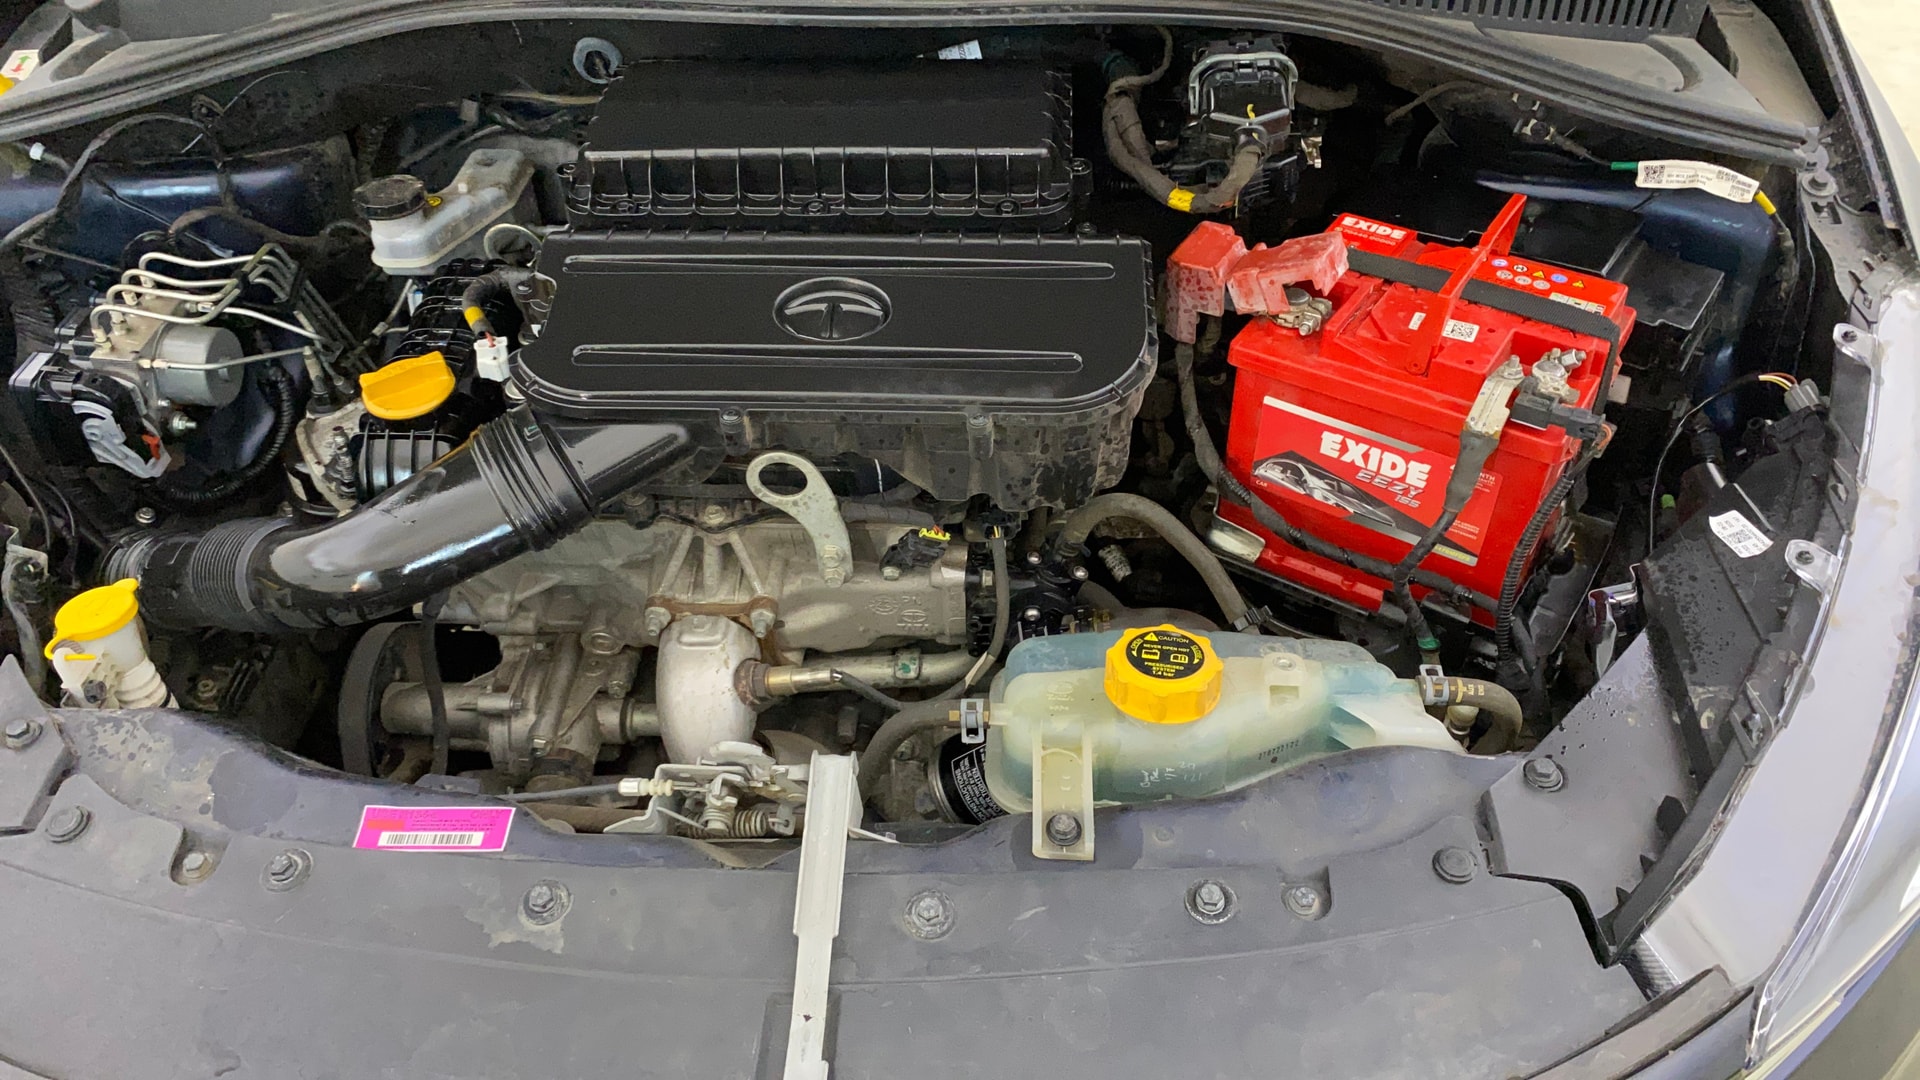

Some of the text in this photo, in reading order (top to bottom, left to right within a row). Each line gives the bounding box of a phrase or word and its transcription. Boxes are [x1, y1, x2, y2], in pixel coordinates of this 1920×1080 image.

[1342, 216, 1407, 239] EXIDE
[1319, 431, 1432, 489] EXIDE
[1255, 480, 1268, 488] CAR
[1356, 470, 1425, 499] EEZY
[1479, 472, 1496, 482] NTH
[1130, 638, 1143, 650] OPEN
[1144, 661, 1185, 671] PRESSURISED
[955, 768, 979, 813] INSTRUCTIONS
[971, 767, 988, 797] TIGHTEN
[985, 796, 1001, 813] OVER
